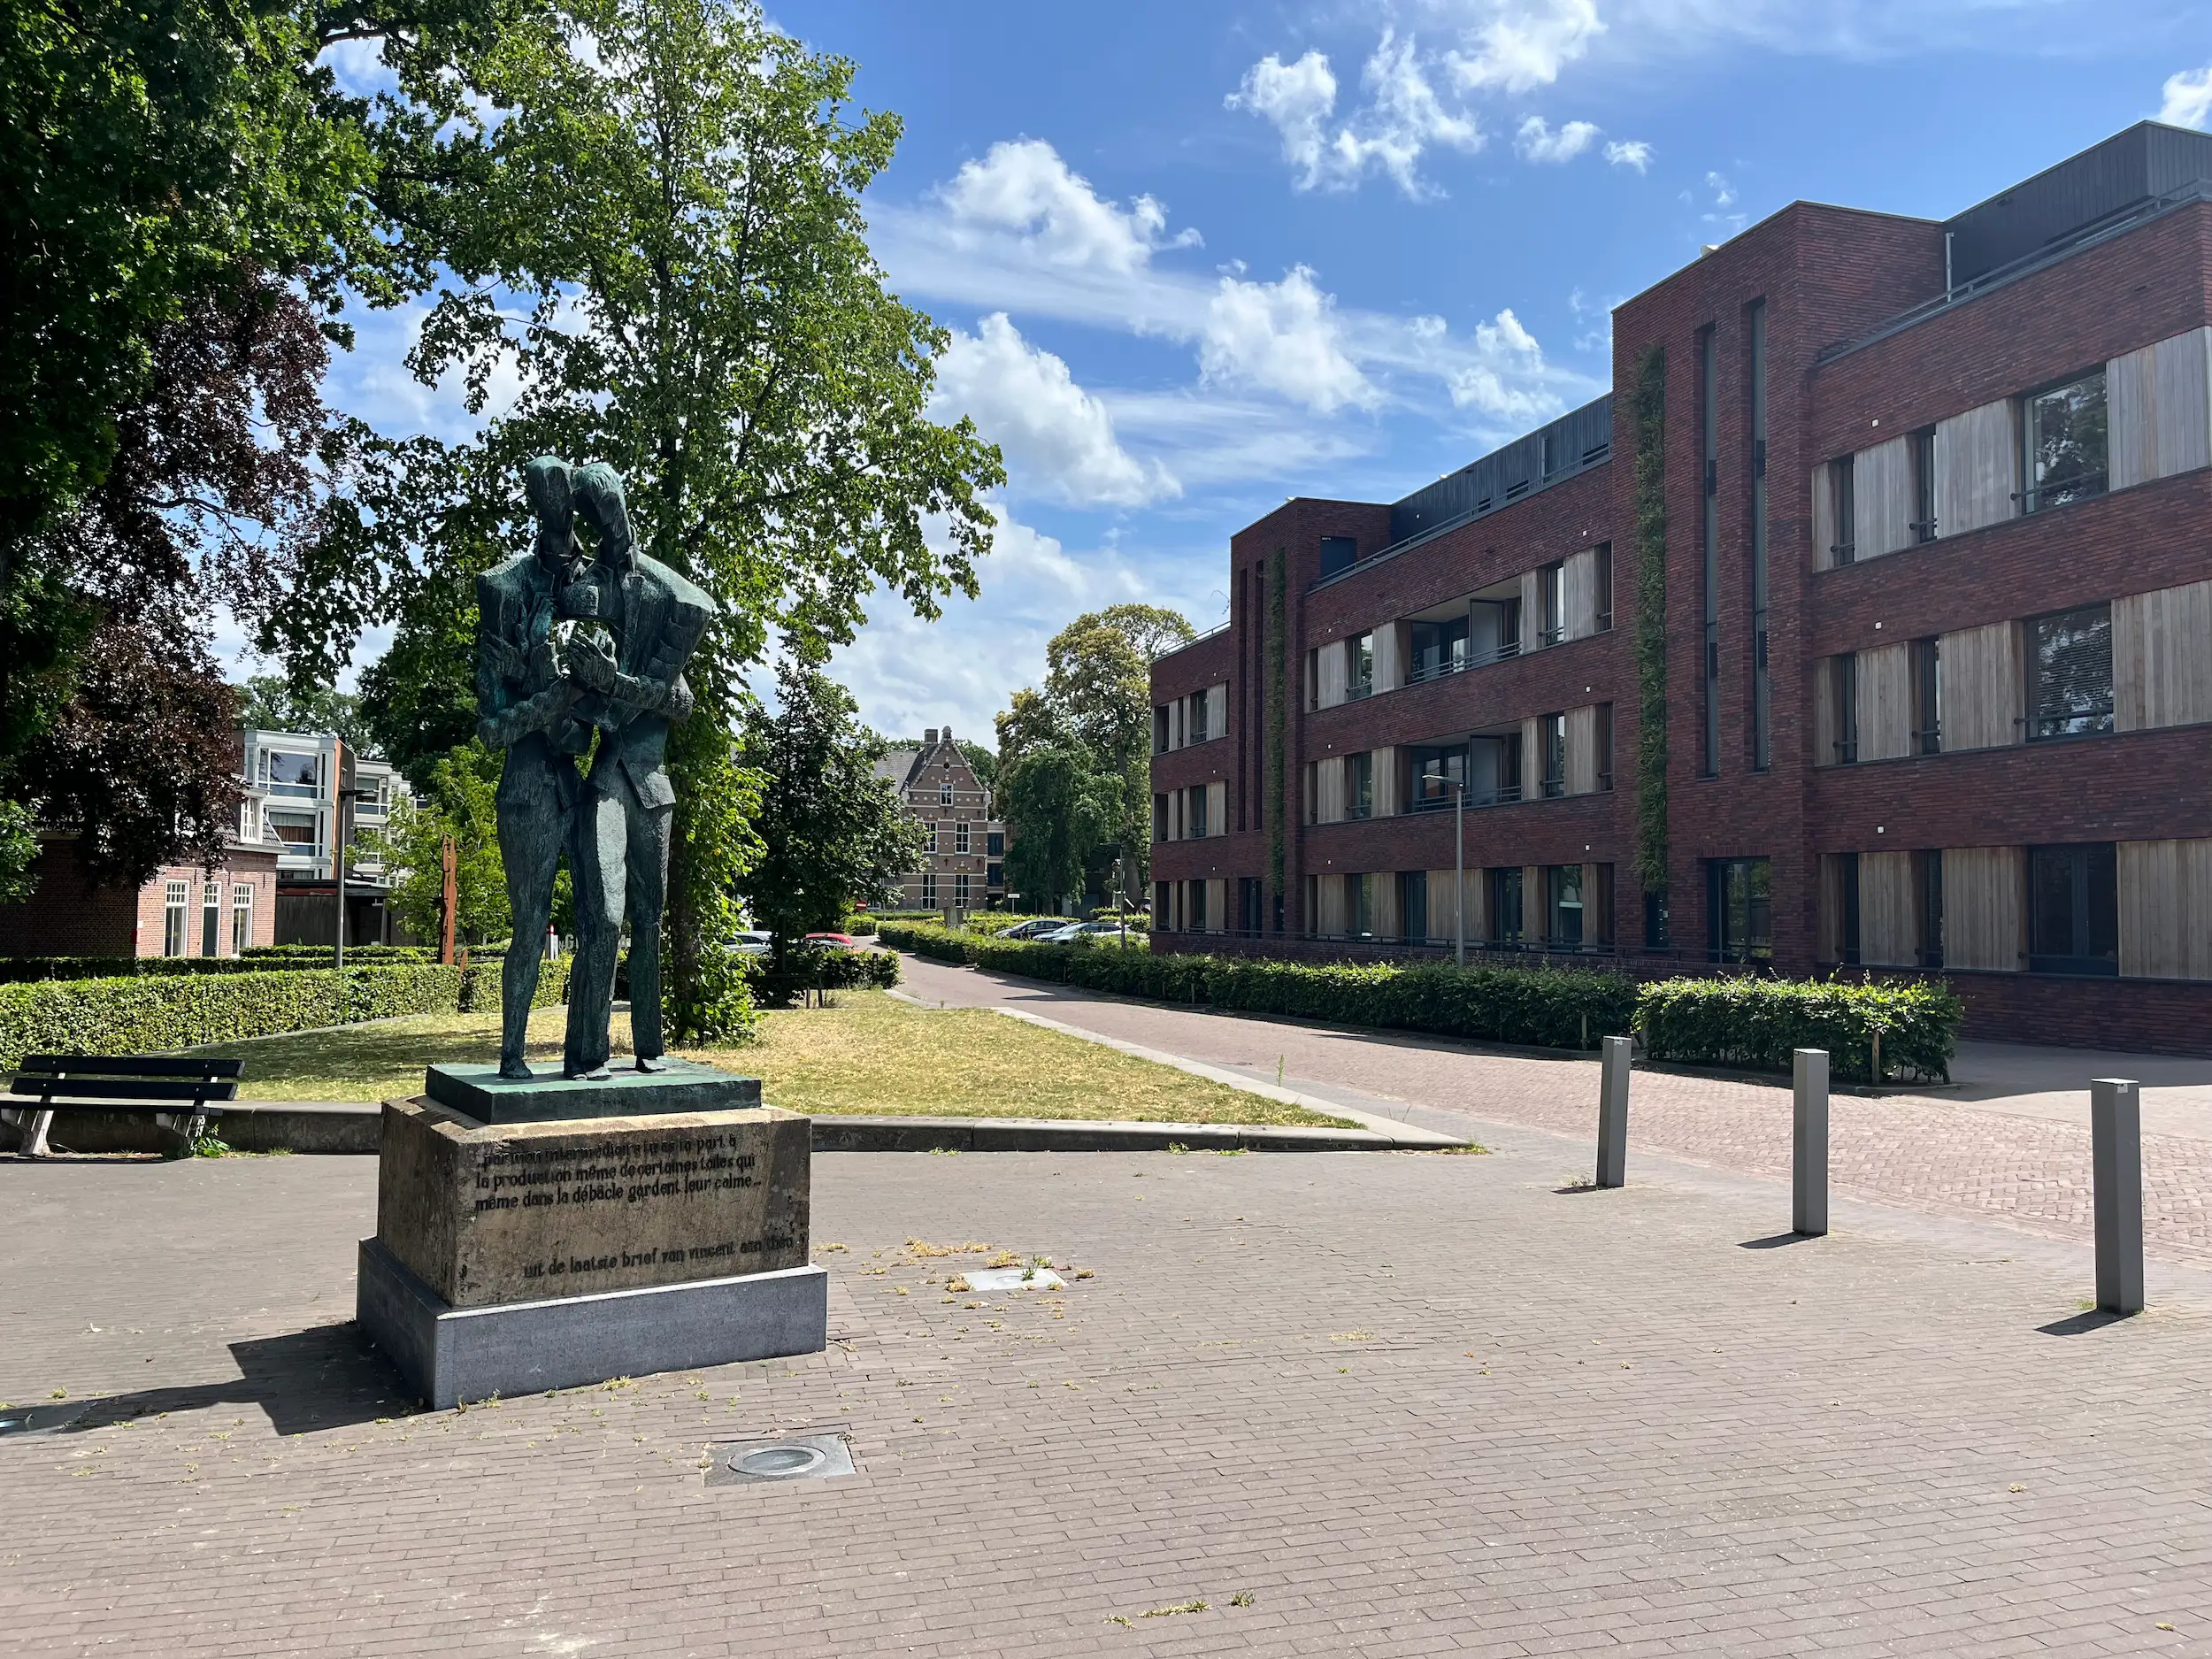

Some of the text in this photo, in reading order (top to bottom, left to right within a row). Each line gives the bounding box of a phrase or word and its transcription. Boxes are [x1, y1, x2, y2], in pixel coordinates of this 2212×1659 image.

[696, 1134, 725, 1154] part
[476, 1153, 756, 1191] la production même de certaines toiles qui
[475, 1194, 518, 1211] même
[522, 1190, 554, 1208] dans
[557, 1186, 569, 1205] la
[572, 1183, 624, 1204] débâcle
[629, 1179, 681, 1203] gardent
[685, 1176, 711, 1194] leur
[524, 1260, 545, 1278] uit
[549, 1258, 566, 1275] de
[622, 1248, 658, 1267] brief
[662, 1249, 685, 1263] van
[688, 1241, 734, 1260] vincent
[740, 1240, 763, 1254] aan
